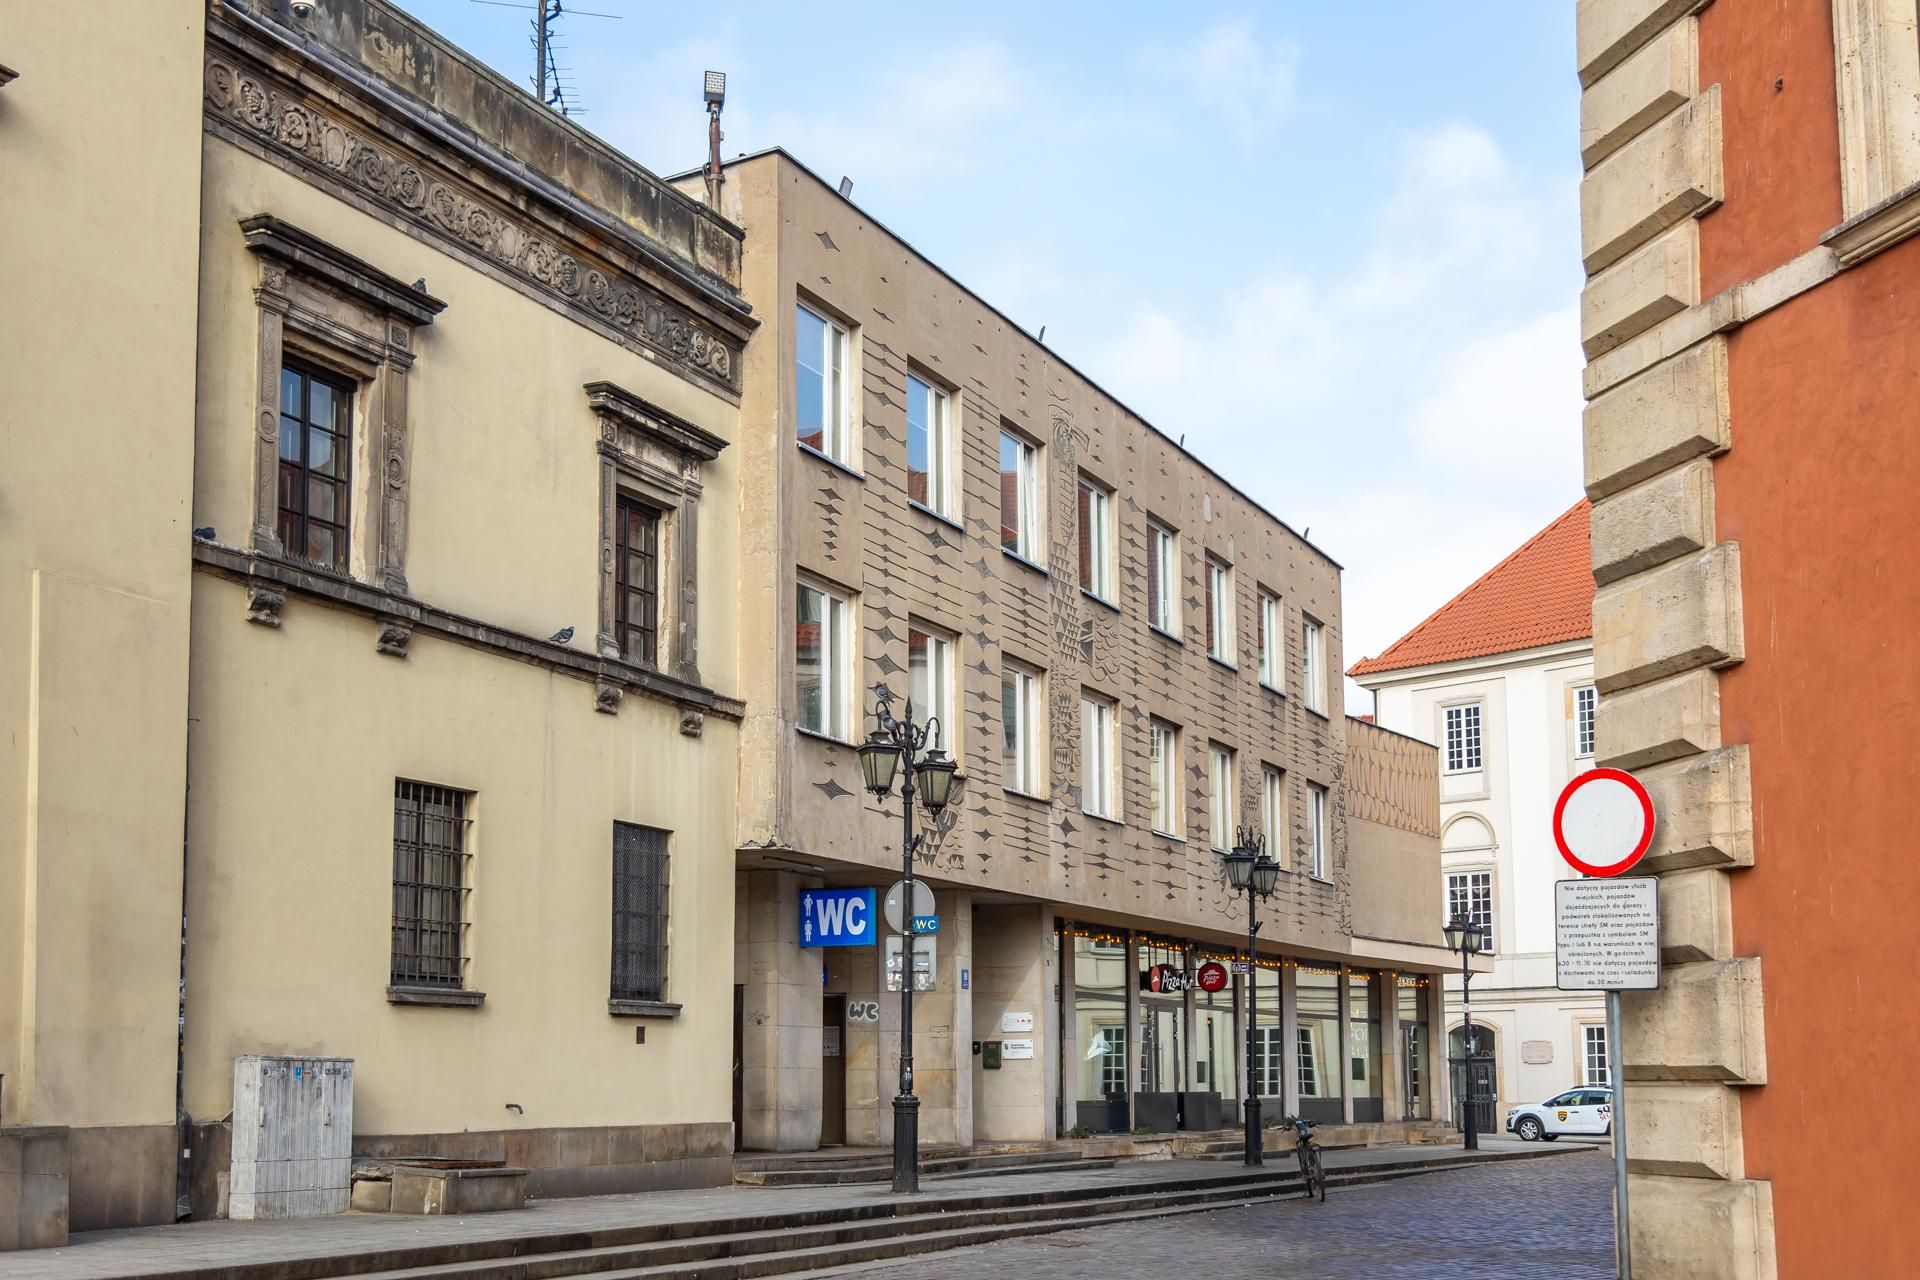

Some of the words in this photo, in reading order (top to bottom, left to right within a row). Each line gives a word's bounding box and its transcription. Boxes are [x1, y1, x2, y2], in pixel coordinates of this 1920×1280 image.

[816, 896, 866, 937] WC
[915, 919, 937, 931] WC
[1161, 970, 1180, 991] Pizza
[1180, 973, 1193, 991] Hut
[848, 1002, 879, 1021] WC
